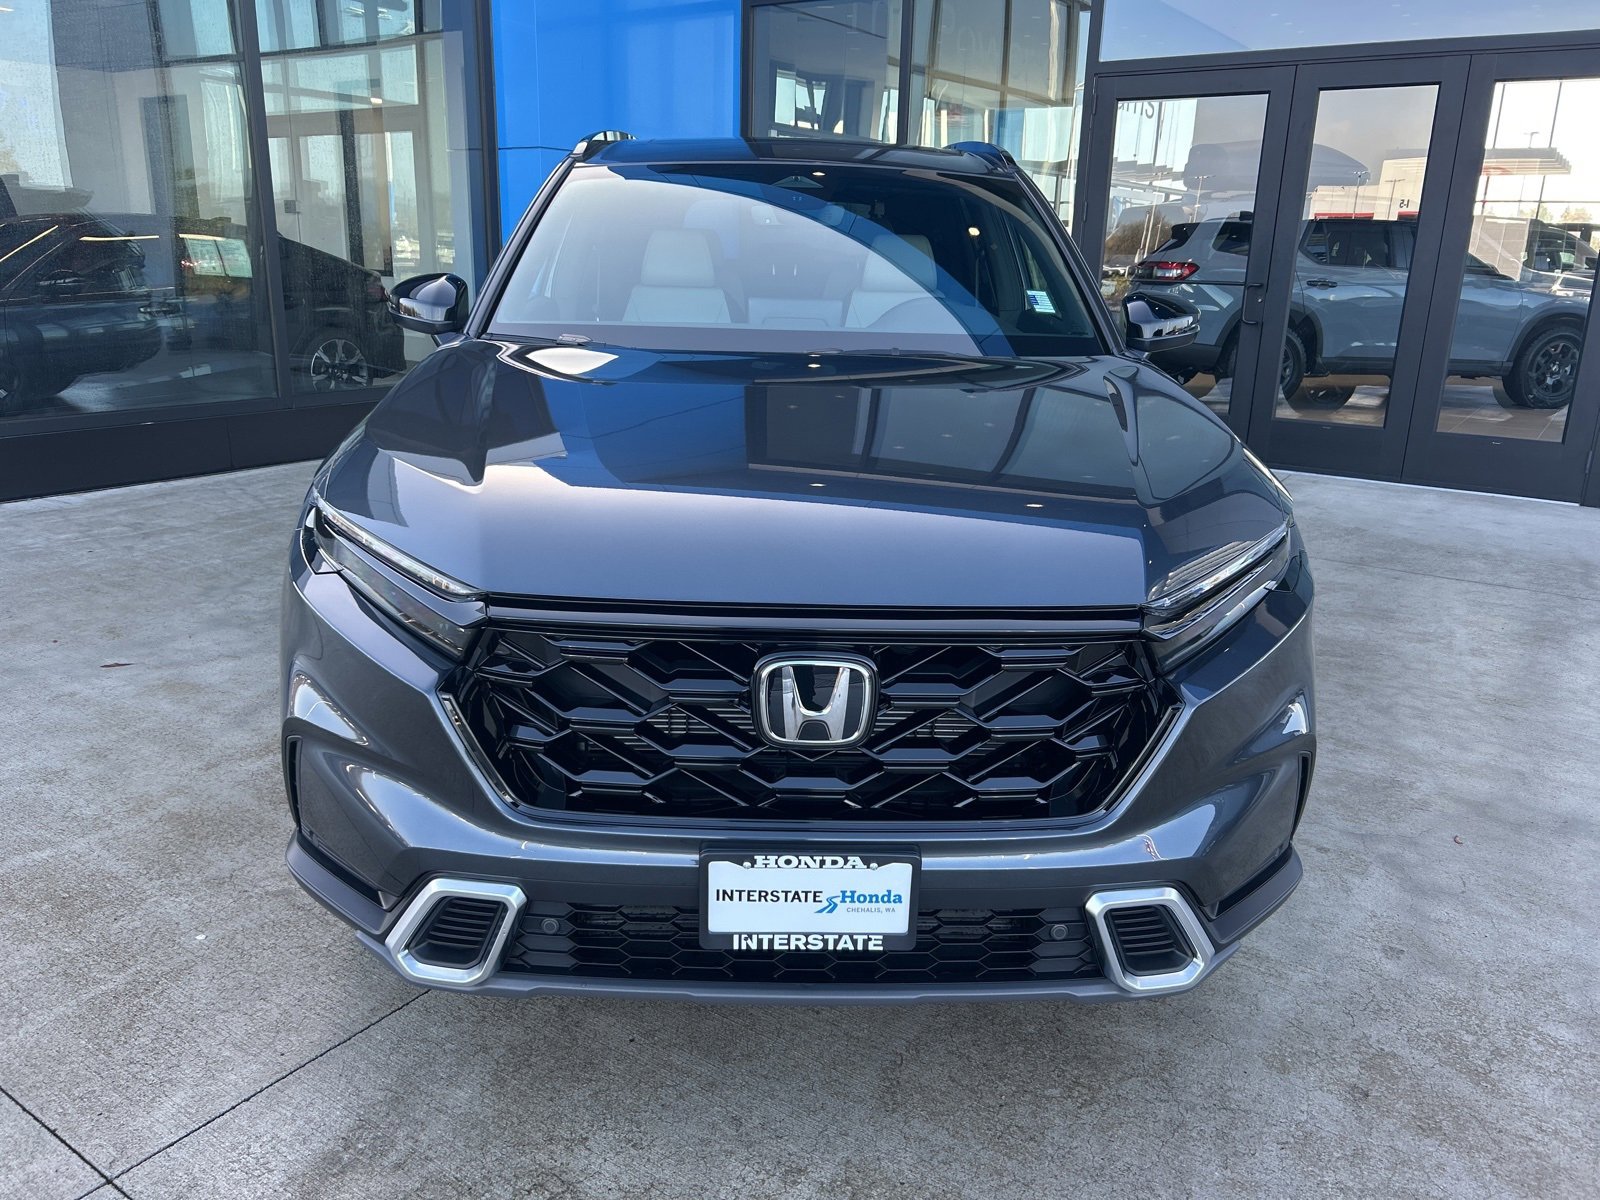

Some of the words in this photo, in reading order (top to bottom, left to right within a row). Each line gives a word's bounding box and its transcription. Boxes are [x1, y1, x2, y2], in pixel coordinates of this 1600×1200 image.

[754, 855, 867, 869] HONDA
[716, 889, 823, 903] INTERSTATE
[840, 889, 903, 904] Honda
[846, 906, 883, 914] CHEHALIS,
[733, 934, 883, 951] INTERSTATE
